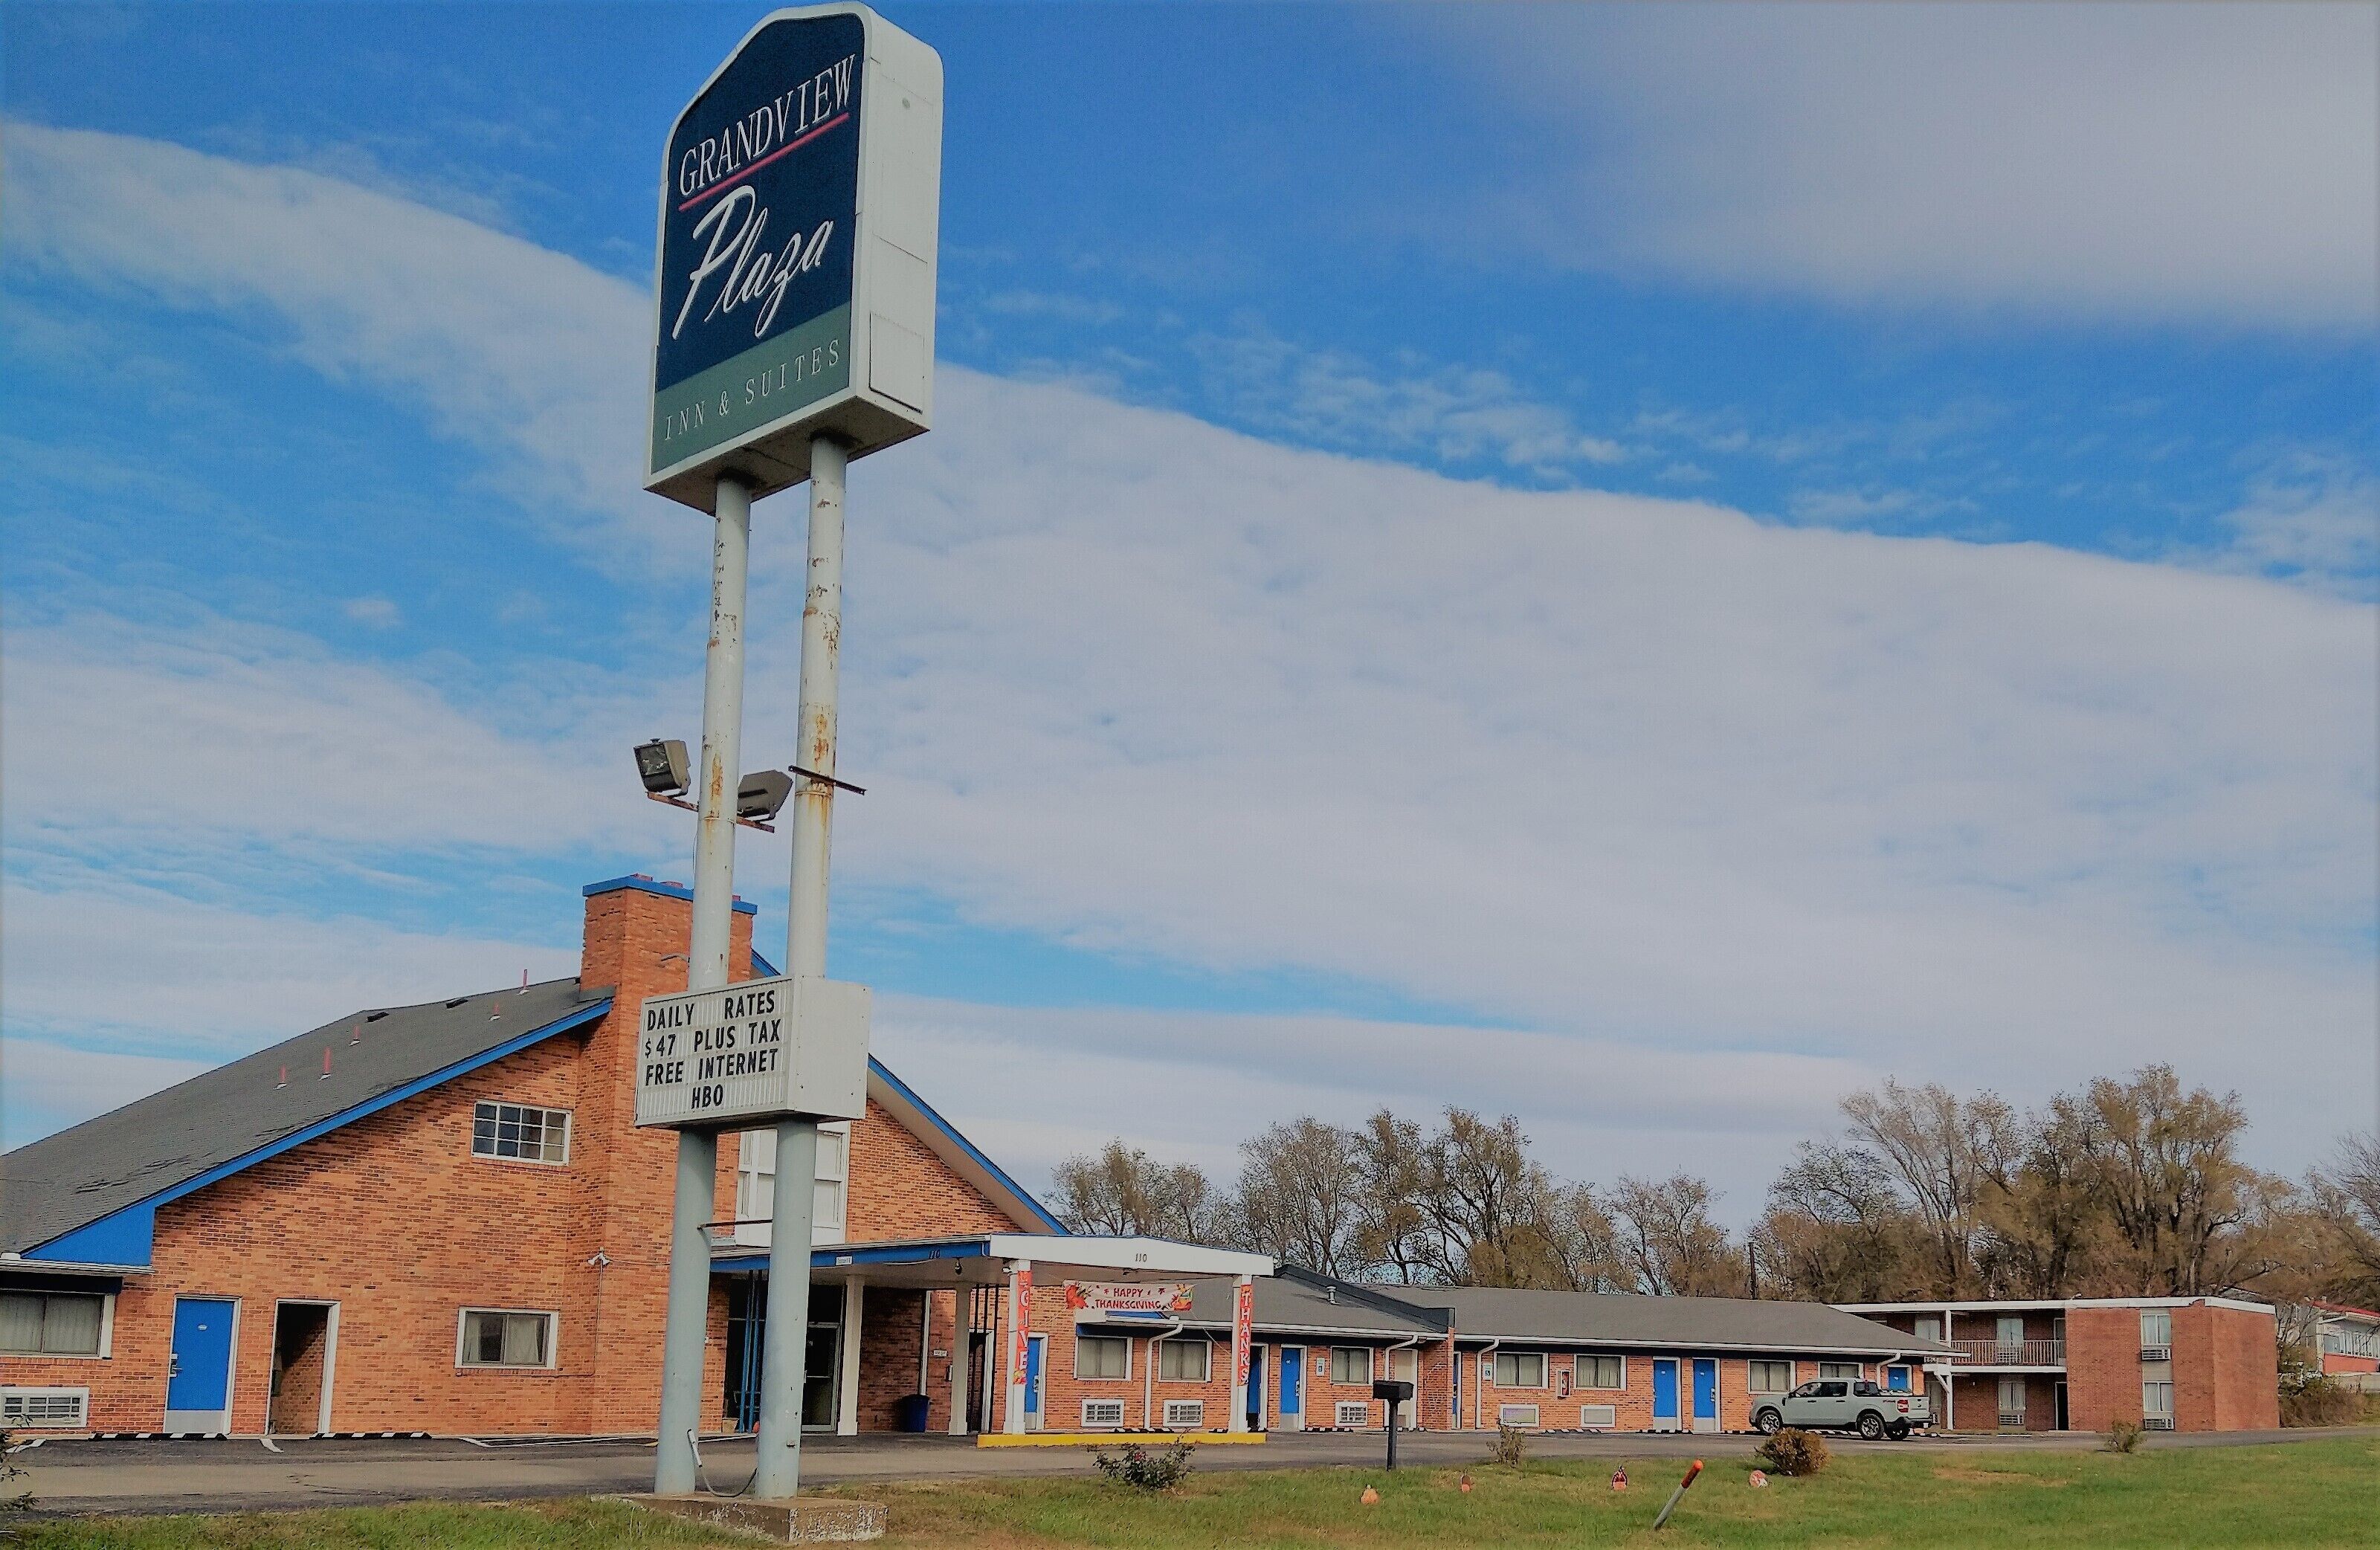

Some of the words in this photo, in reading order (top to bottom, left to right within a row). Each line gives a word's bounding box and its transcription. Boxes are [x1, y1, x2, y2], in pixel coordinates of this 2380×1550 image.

[680, 54, 856, 196] GRANDVIEW
[672, 185, 834, 340] Plaza
[665, 401, 705, 441] INN
[718, 391, 729, 416] &
[744, 339, 840, 406] SUITES
[647, 1004, 694, 1031] DAILY
[724, 990, 775, 1019] RATES
[645, 1034, 676, 1058] $47
[694, 1026, 735, 1052] PLUS
[749, 1019, 781, 1044] TAX
[645, 1061, 683, 1085] FREE
[698, 1049, 778, 1080] INTERNET
[691, 1084, 723, 1109] HBO
[1135, 1253, 1147, 1262] 110
[1095, 1299, 1161, 1309] THANKSGIVING
[1114, 1288, 1144, 1297] HAPPY
[1240, 1293, 1250, 1383] THANKS
